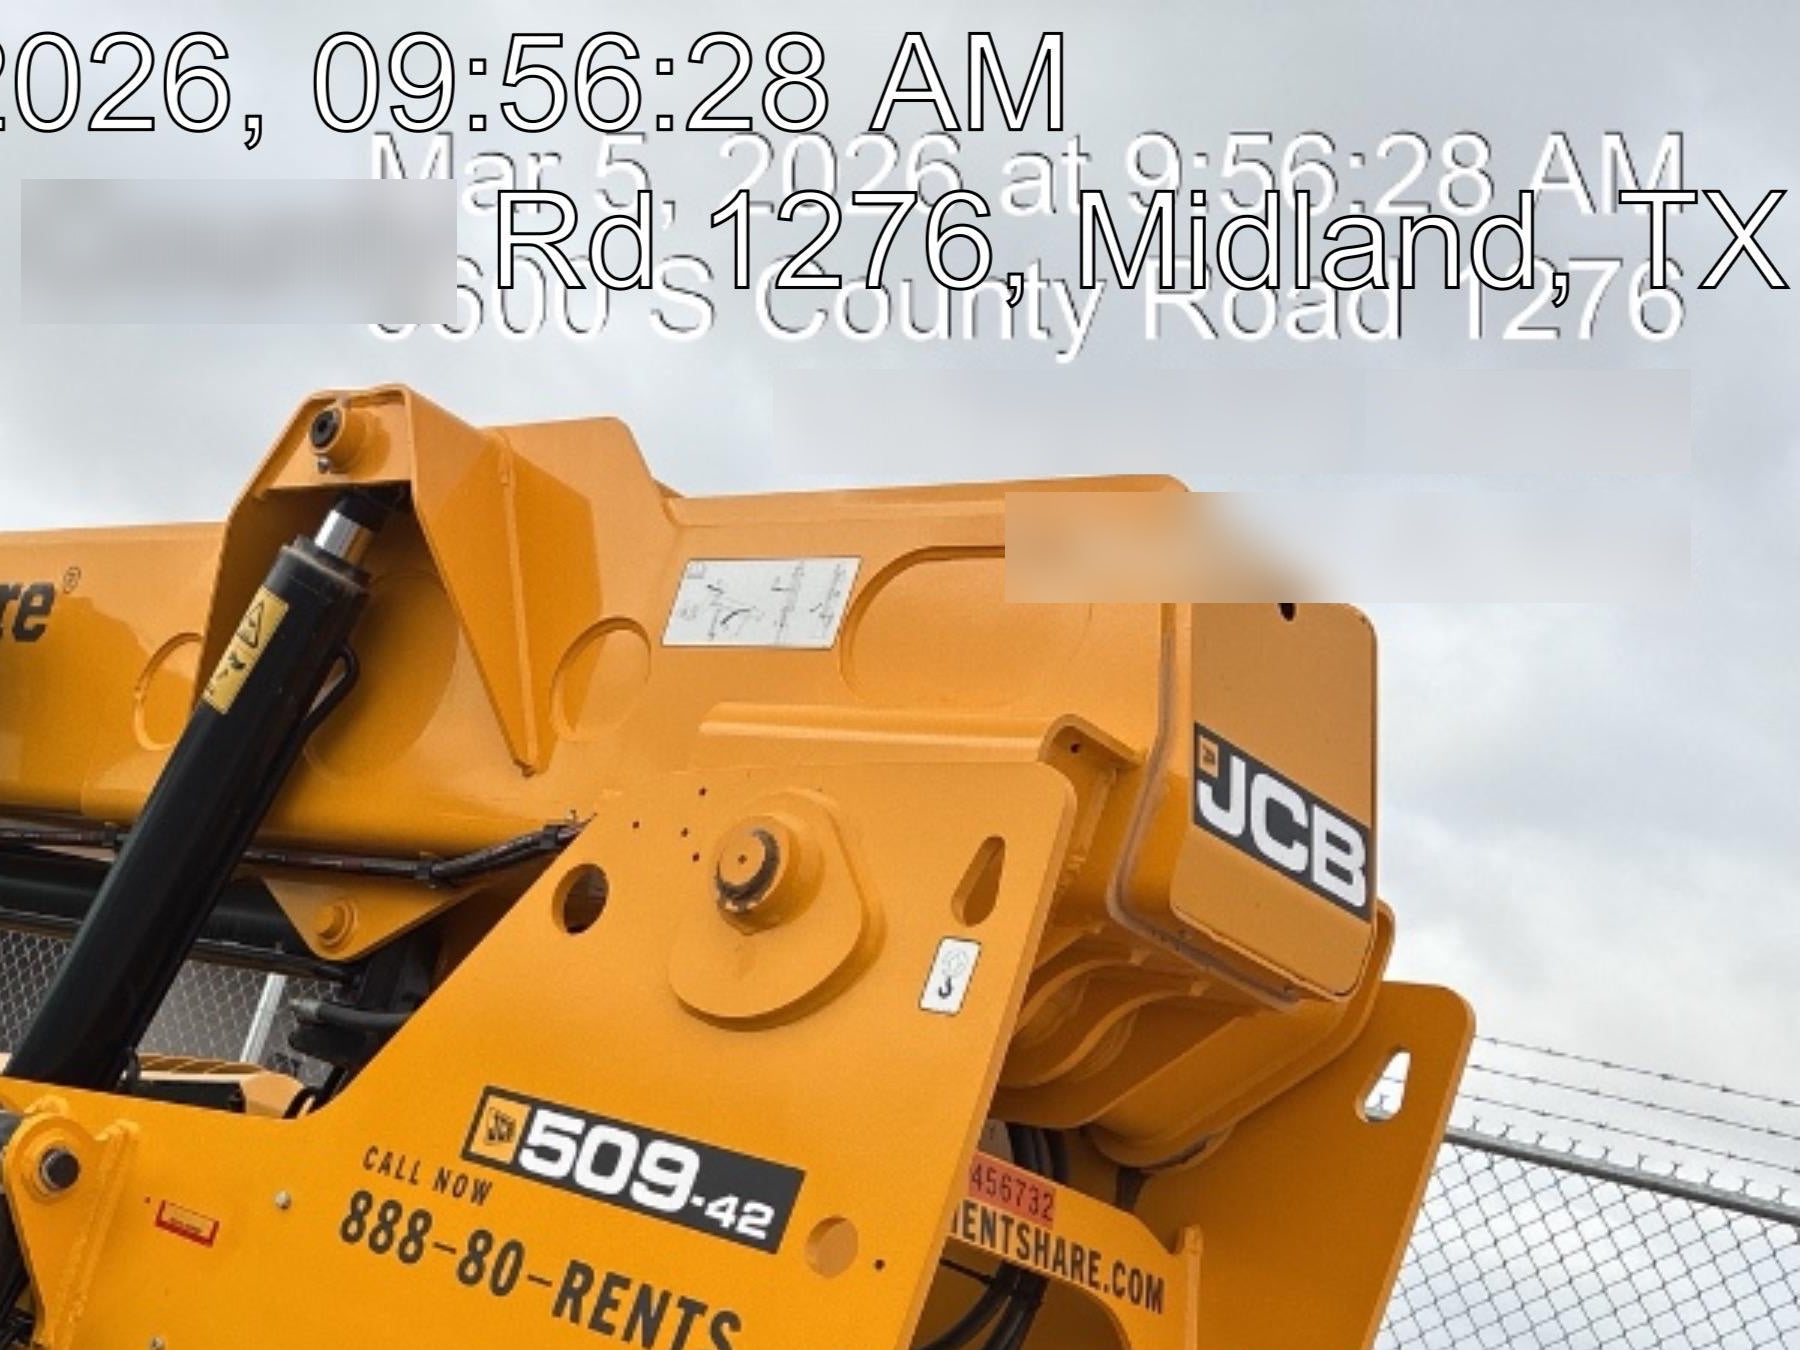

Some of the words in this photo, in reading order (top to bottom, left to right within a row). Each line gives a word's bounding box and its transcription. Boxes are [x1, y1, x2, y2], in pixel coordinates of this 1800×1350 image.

[1196, 754, 1367, 908] JCB
[362, 1145, 422, 1187] CALL
[431, 1166, 494, 1207] NOW
[951, 1198, 1166, 1315] ENTSHARE.COM
